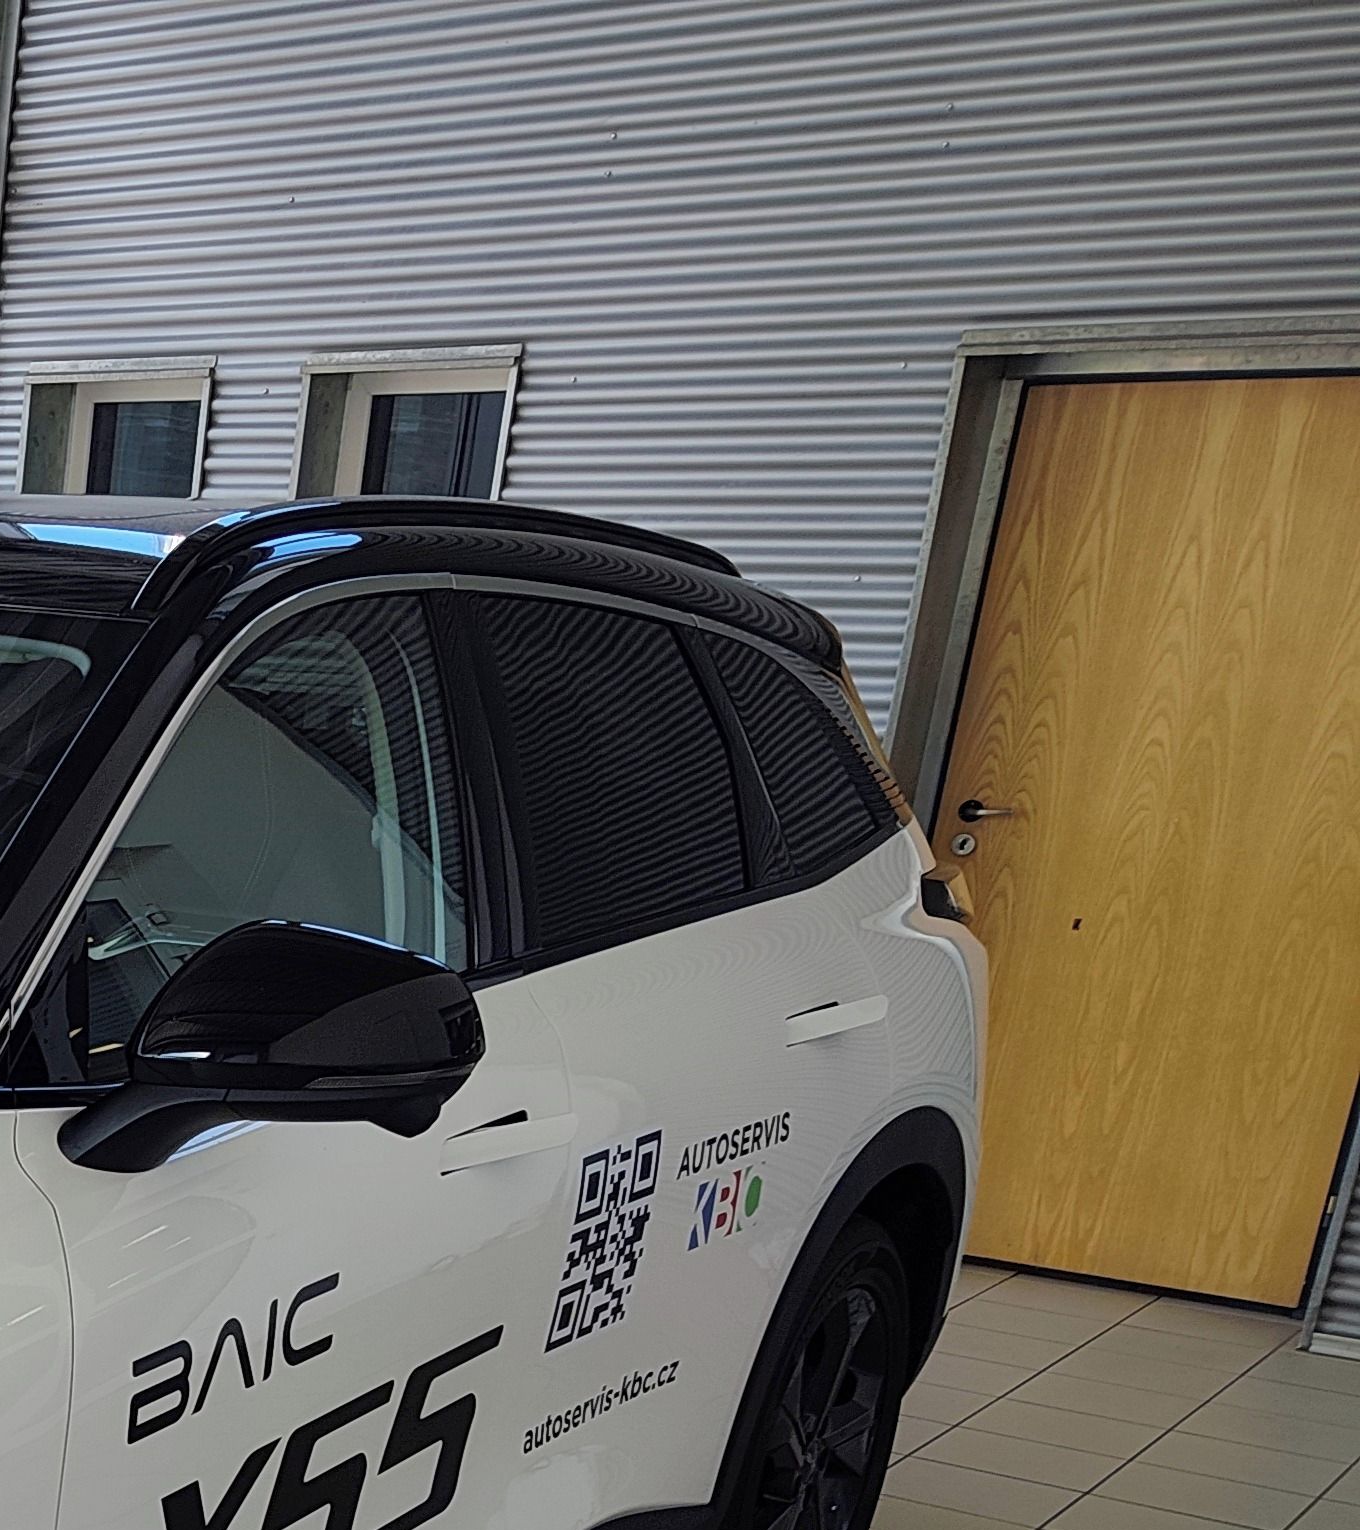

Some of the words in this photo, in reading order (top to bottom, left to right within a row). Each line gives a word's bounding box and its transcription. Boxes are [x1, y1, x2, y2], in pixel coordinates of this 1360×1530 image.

[676, 1111, 790, 1180] AUTOSERVIS
[687, 1161, 766, 1251] KBC
[127, 1272, 340, 1445] BAIC
[523, 1360, 680, 1454] autoservis-kbc.cz
